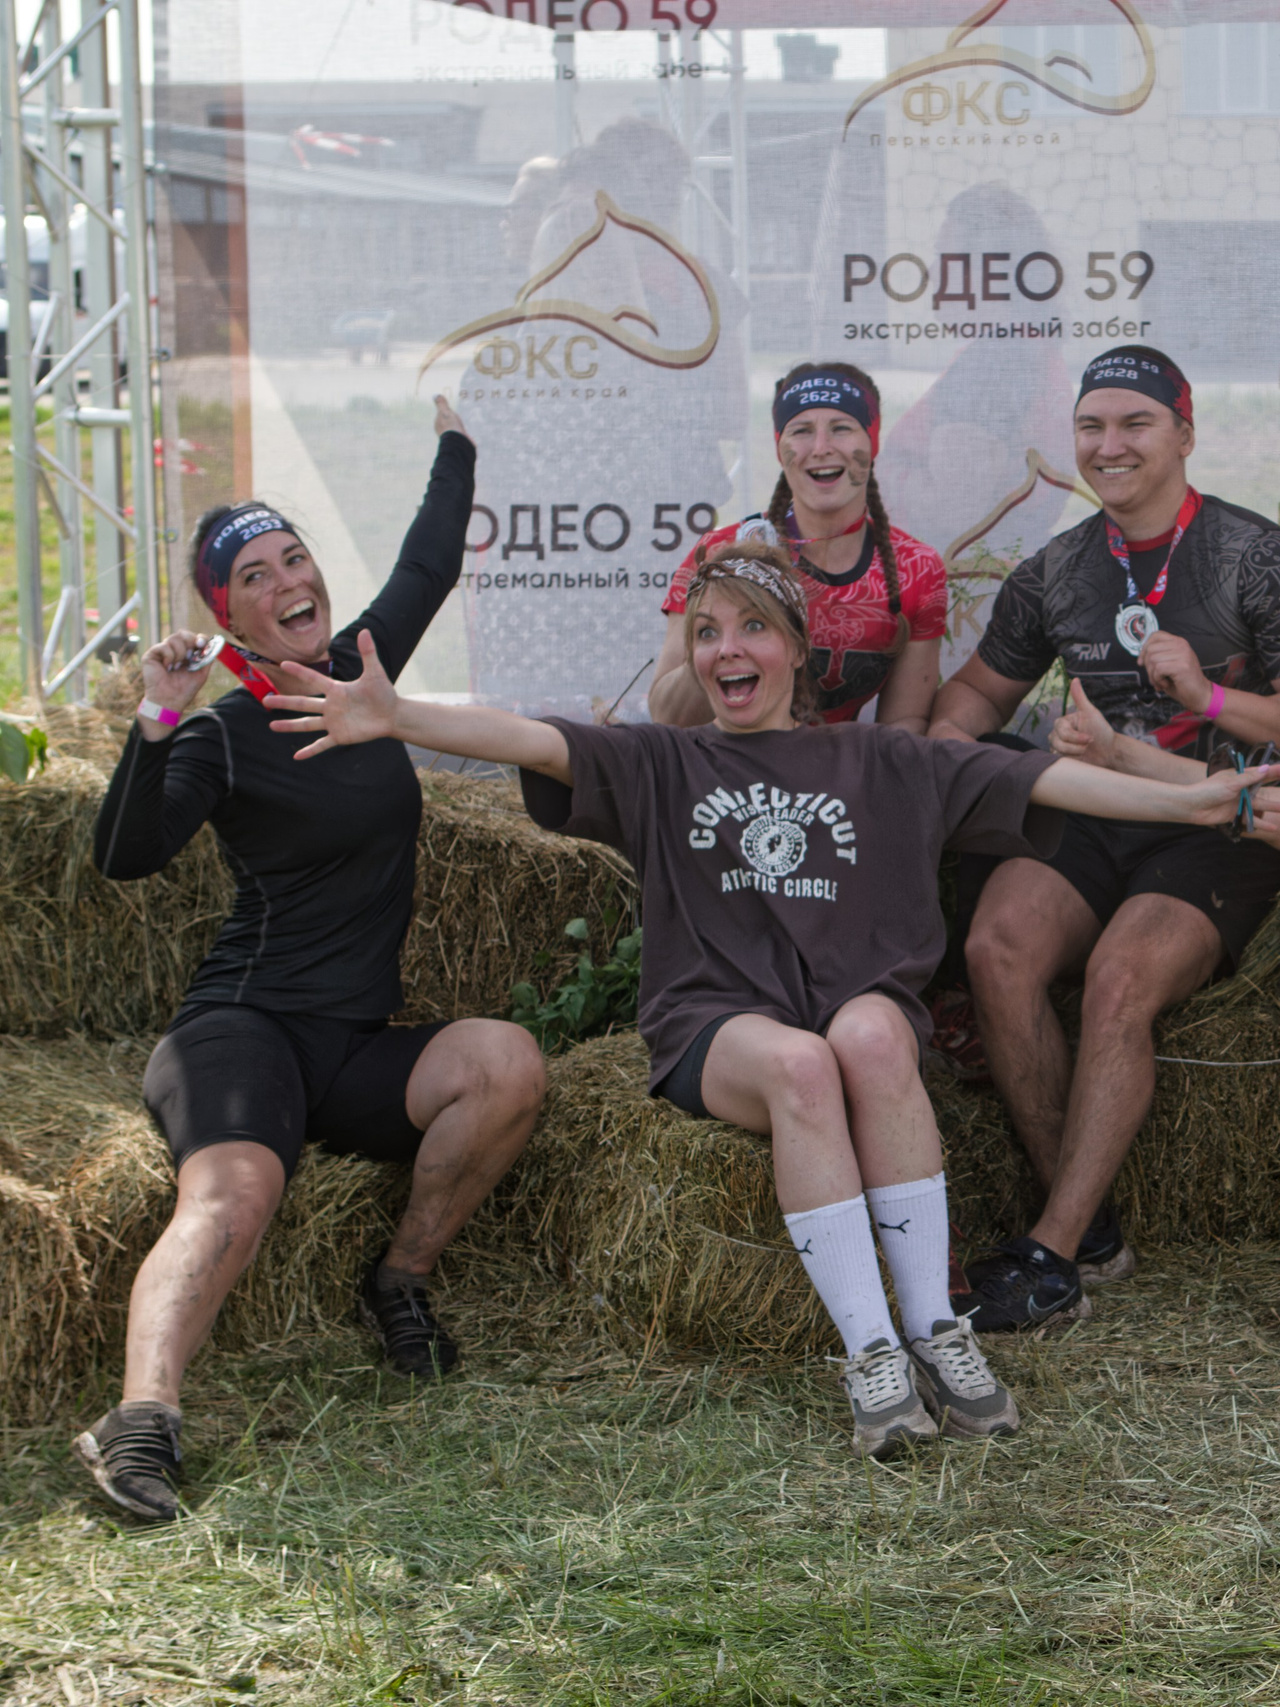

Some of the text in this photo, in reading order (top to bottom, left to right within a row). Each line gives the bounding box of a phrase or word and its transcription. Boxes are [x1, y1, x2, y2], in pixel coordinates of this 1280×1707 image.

[651, 0, 718, 42] 59
[902, 82, 1030, 126] ФКС
[870, 132, 1061, 147] Пермский край
[844, 250, 1154, 311] РОДЕО 59
[844, 316, 1152, 344] экстремальный забег
[473, 335, 599, 380] ФКС
[1086, 356, 1160, 374] РОДЕО 59
[1093, 367, 1138, 380] 2628
[782, 377, 838, 401] РОДЕО
[799, 390, 841, 405] 2622
[213, 510, 271, 549] РОДЕО
[465, 503, 630, 560] ОДЕО
[784, 878, 838, 902] CIRCLE
